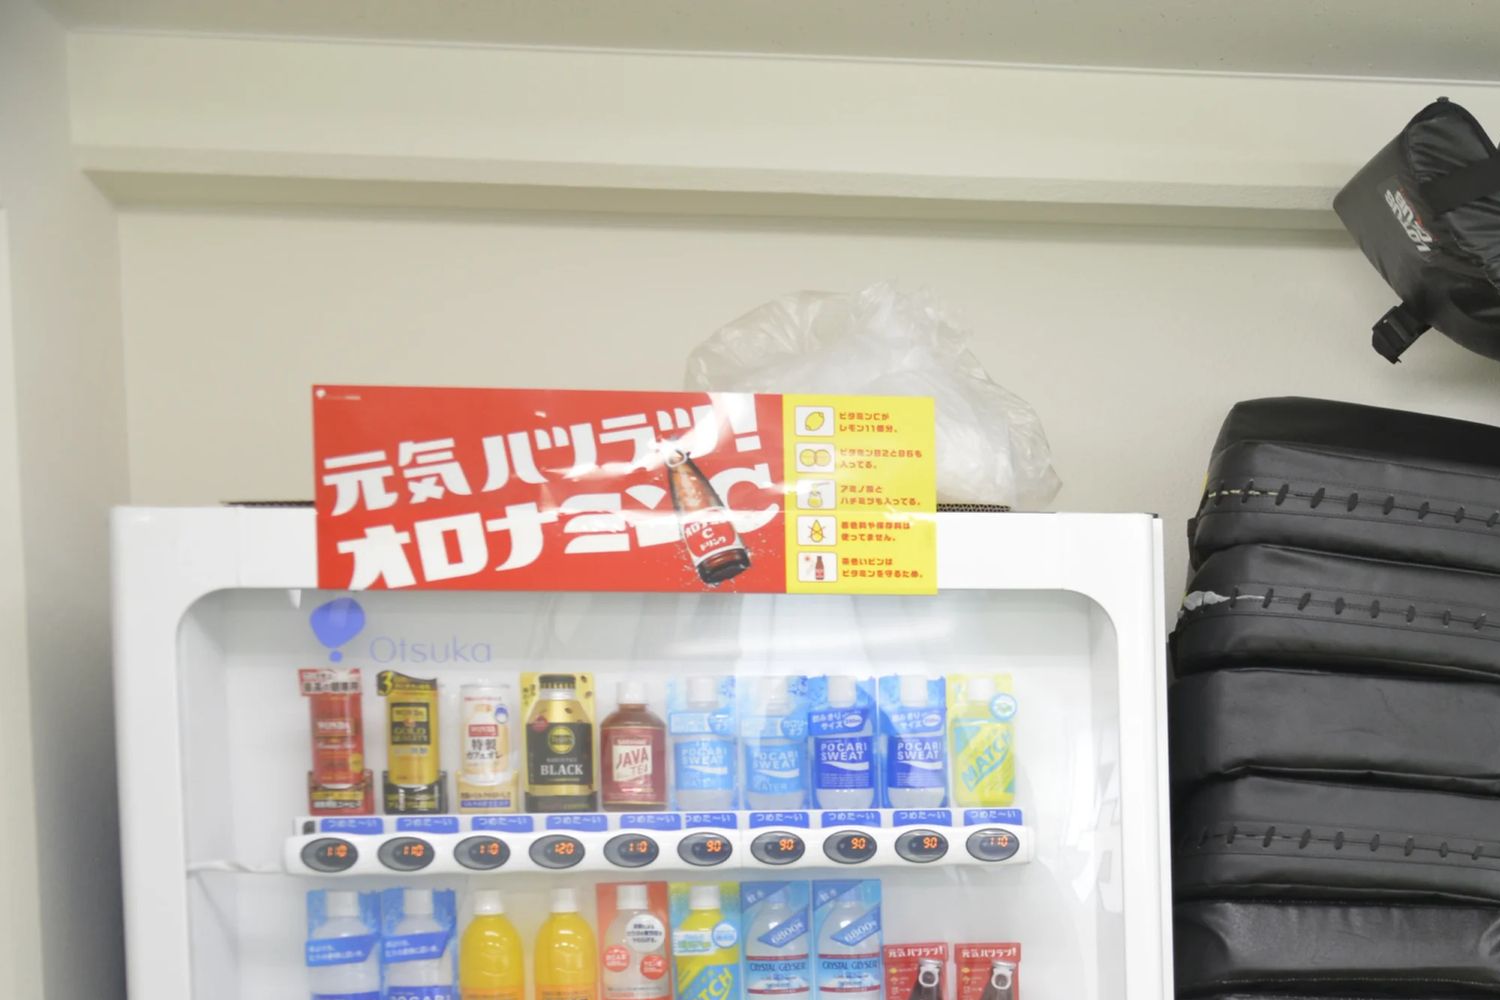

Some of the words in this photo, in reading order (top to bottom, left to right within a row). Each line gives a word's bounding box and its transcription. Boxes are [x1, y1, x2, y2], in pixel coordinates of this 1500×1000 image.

[369, 636, 493, 664] Otsuka
[821, 742, 867, 752] POCARI
[616, 747, 649, 770] JAVA
[821, 751, 864, 761] SWEAT
[897, 751, 939, 760] SWEAT
[540, 764, 584, 776] BLACK
[554, 841, 575, 855] 120
[706, 839, 722, 853] 90
[779, 838, 795, 850] 90
[851, 837, 866, 849] 90
[923, 836, 938, 849] 90
